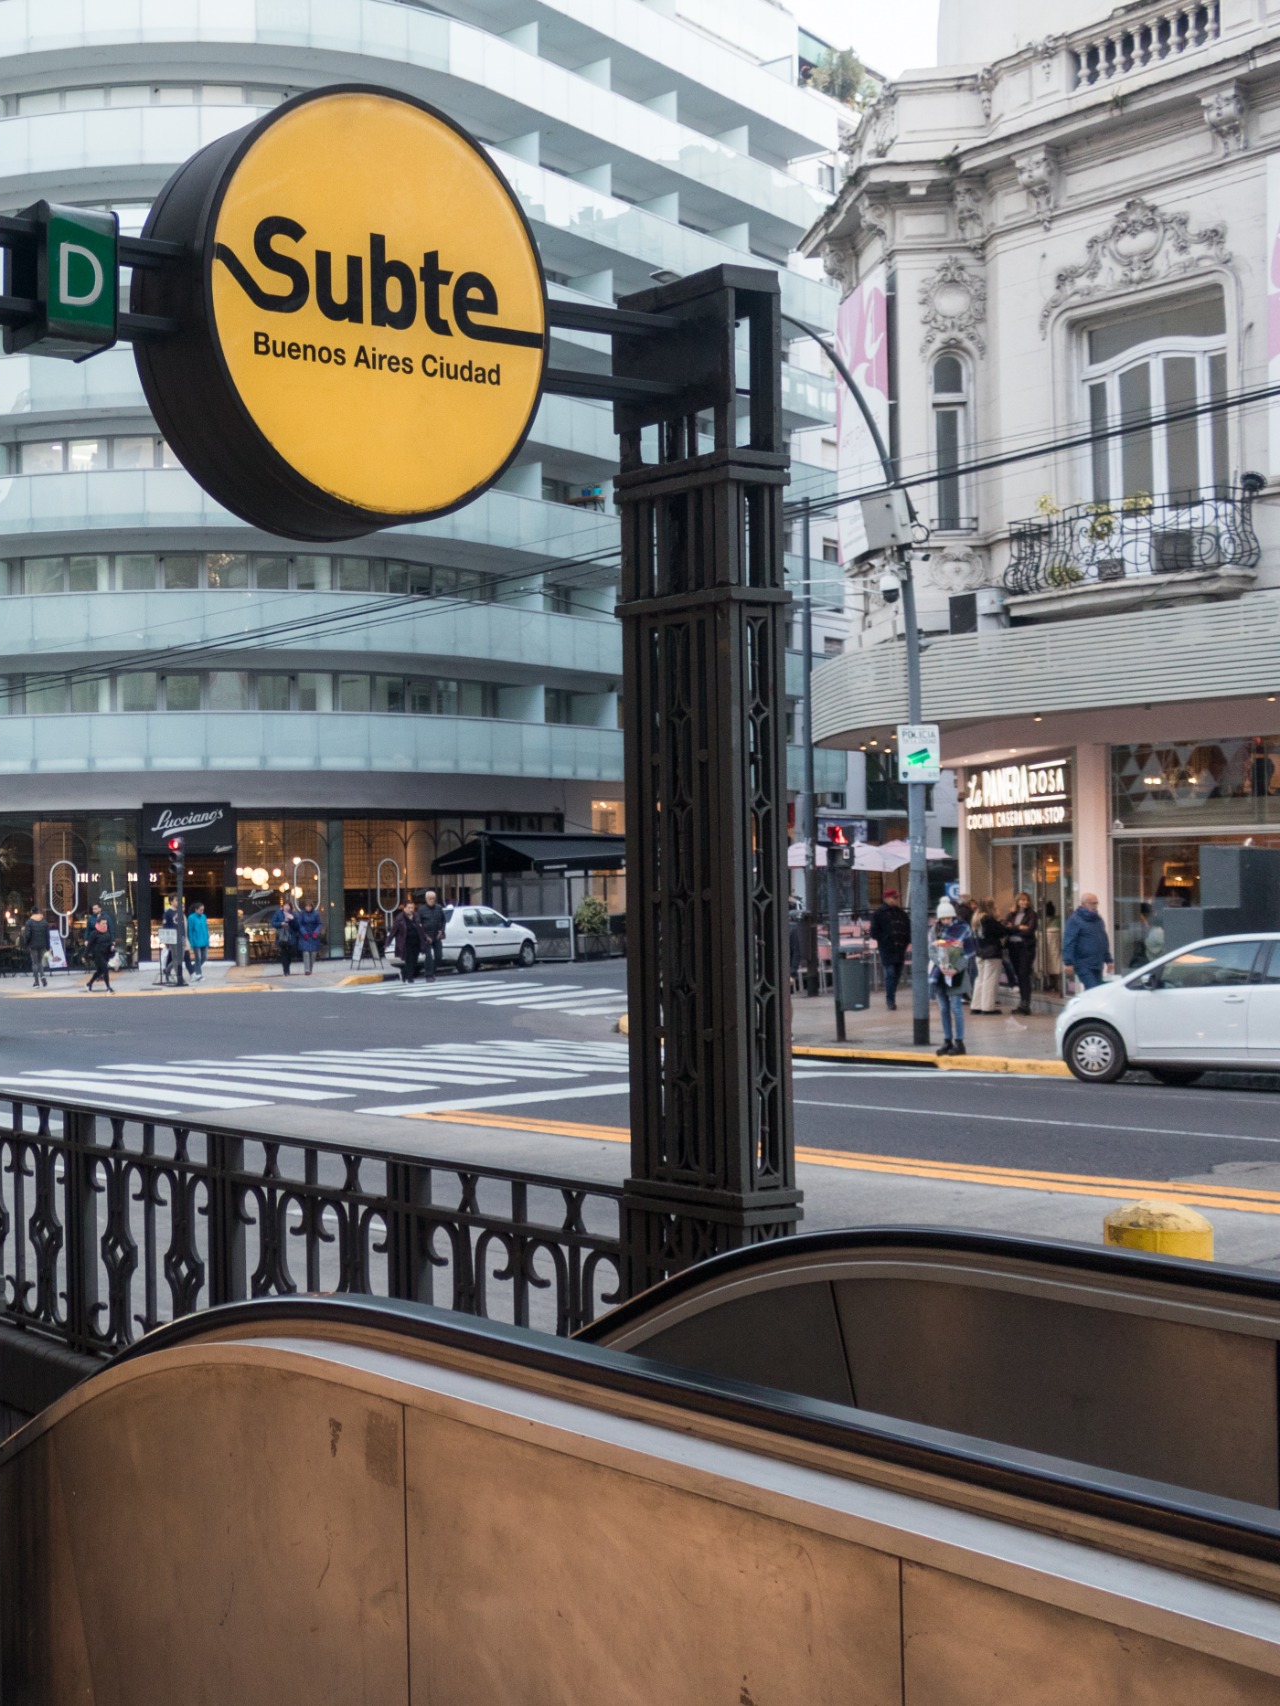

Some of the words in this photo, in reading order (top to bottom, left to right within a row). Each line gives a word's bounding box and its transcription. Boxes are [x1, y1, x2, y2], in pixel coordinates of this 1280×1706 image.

[59, 242, 104, 306] D
[249, 215, 501, 341] Subte
[254, 331, 346, 366] Buenos
[354, 344, 414, 374] Aires
[422, 354, 501, 386] Ciudad
[981, 764, 1030, 807] PANERA
[1028, 767, 1065, 794] ROSA
[151, 808, 224, 837] Lucciano's
[966, 812, 994, 830] COCINA
[995, 809, 1024, 827] CASERA
[1023, 806, 1065, 825] NON-STOP
